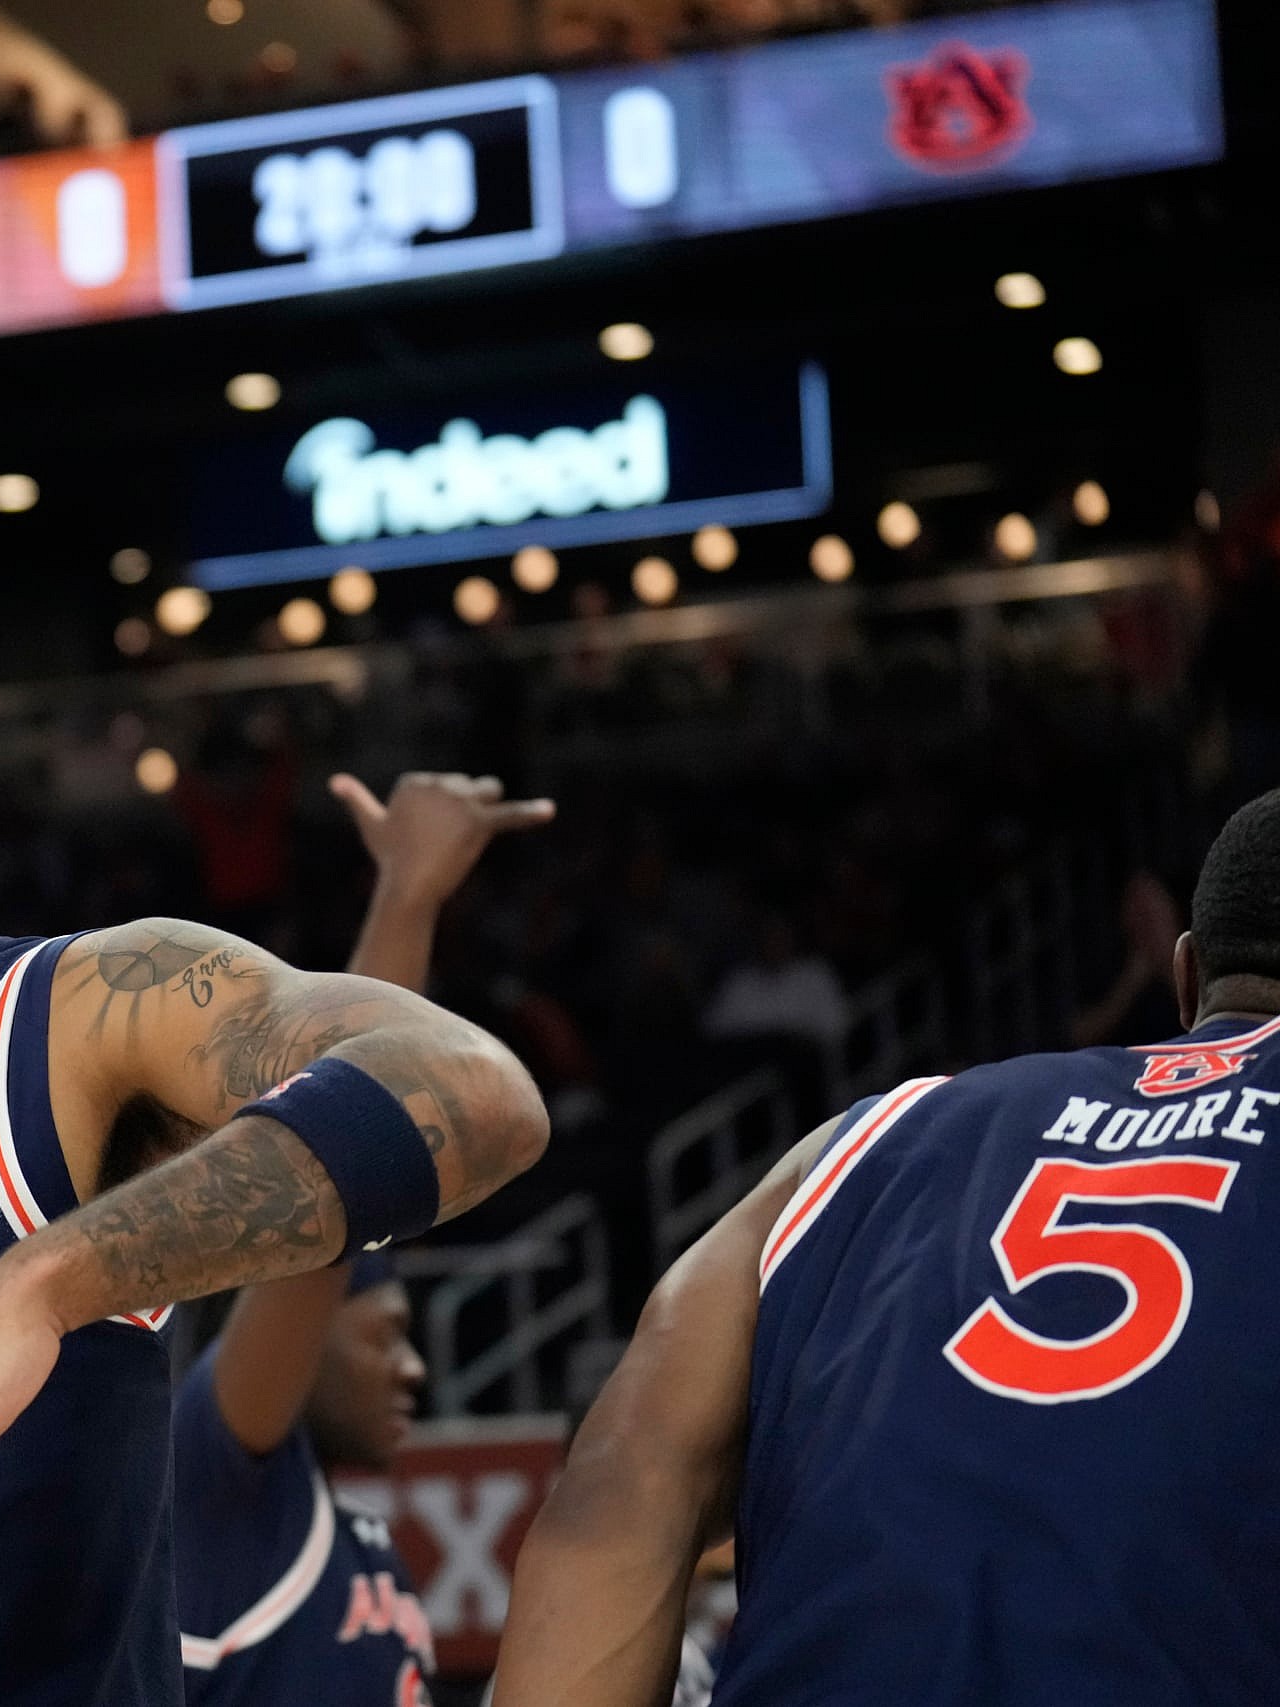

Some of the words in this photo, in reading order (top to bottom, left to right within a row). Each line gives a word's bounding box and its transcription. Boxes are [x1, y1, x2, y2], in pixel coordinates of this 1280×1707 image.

[282, 393, 670, 546] indeed
[1042, 1086, 1280, 1152] MOORE
[942, 1154, 1241, 1406] 5
